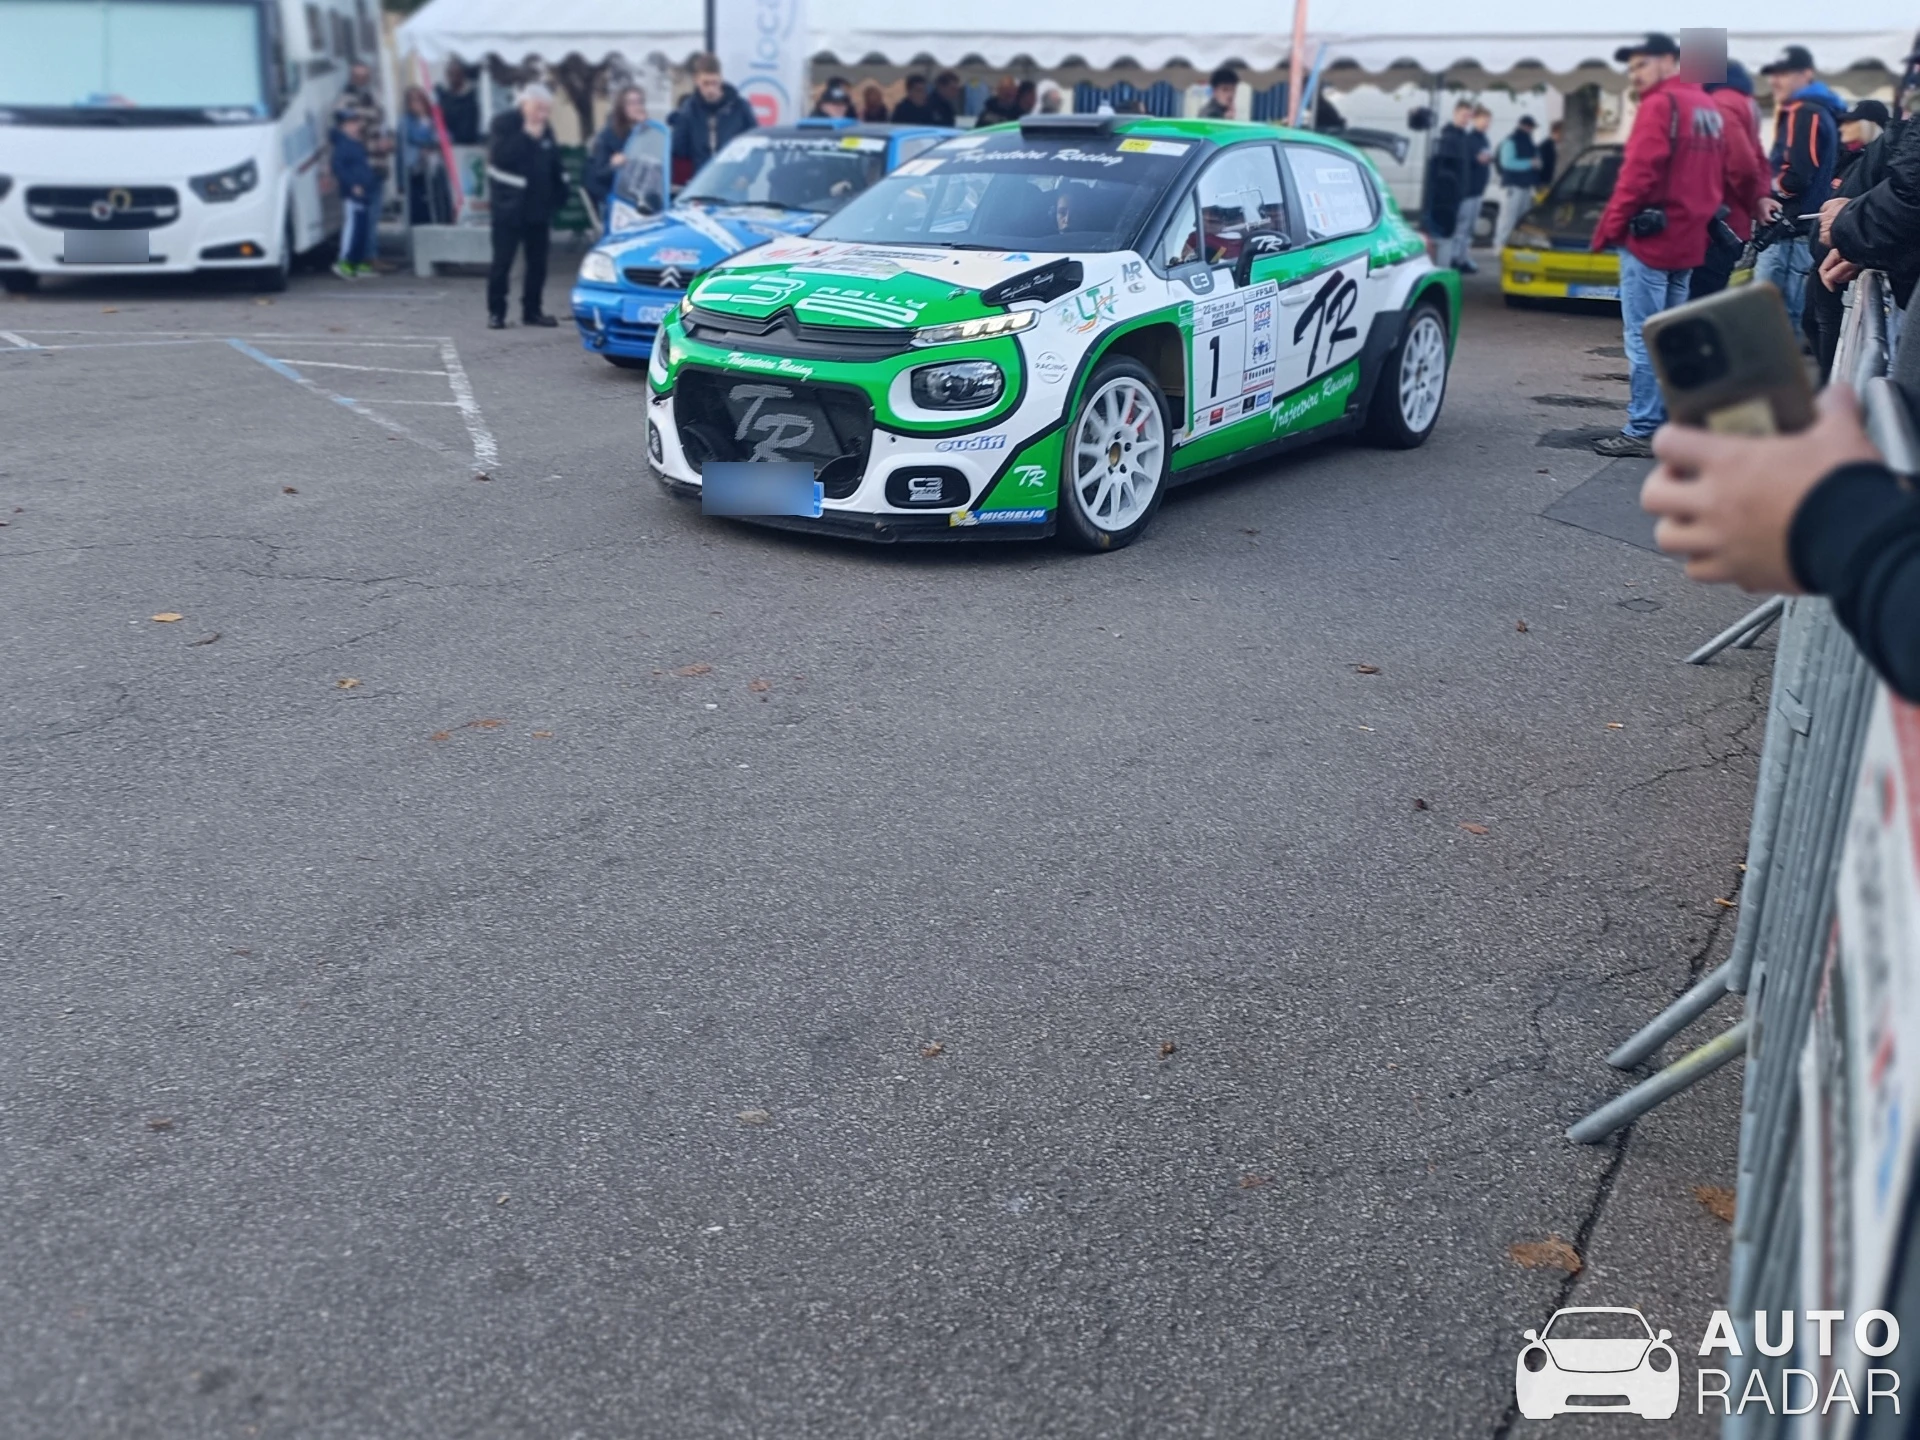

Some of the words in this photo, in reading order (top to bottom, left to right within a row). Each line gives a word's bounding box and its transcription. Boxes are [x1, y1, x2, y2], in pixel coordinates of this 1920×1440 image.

[952, 147, 1047, 165] Trajectoire
[1050, 147, 1124, 167] Racing
[1250, 235, 1284, 252] TR
[690, 274, 807, 306] C3
[1190, 272, 1210, 290] C3
[1292, 269, 1358, 378] TR
[727, 351, 778, 370] Trajectoire
[775, 358, 814, 379] Racing
[1209, 335, 1220, 399] 1
[1269, 391, 1319, 433] Trajectoire
[1322, 370, 1355, 398] Racing
[1013, 464, 1048, 488] TR
[979, 509, 1046, 521] MICHELIN
